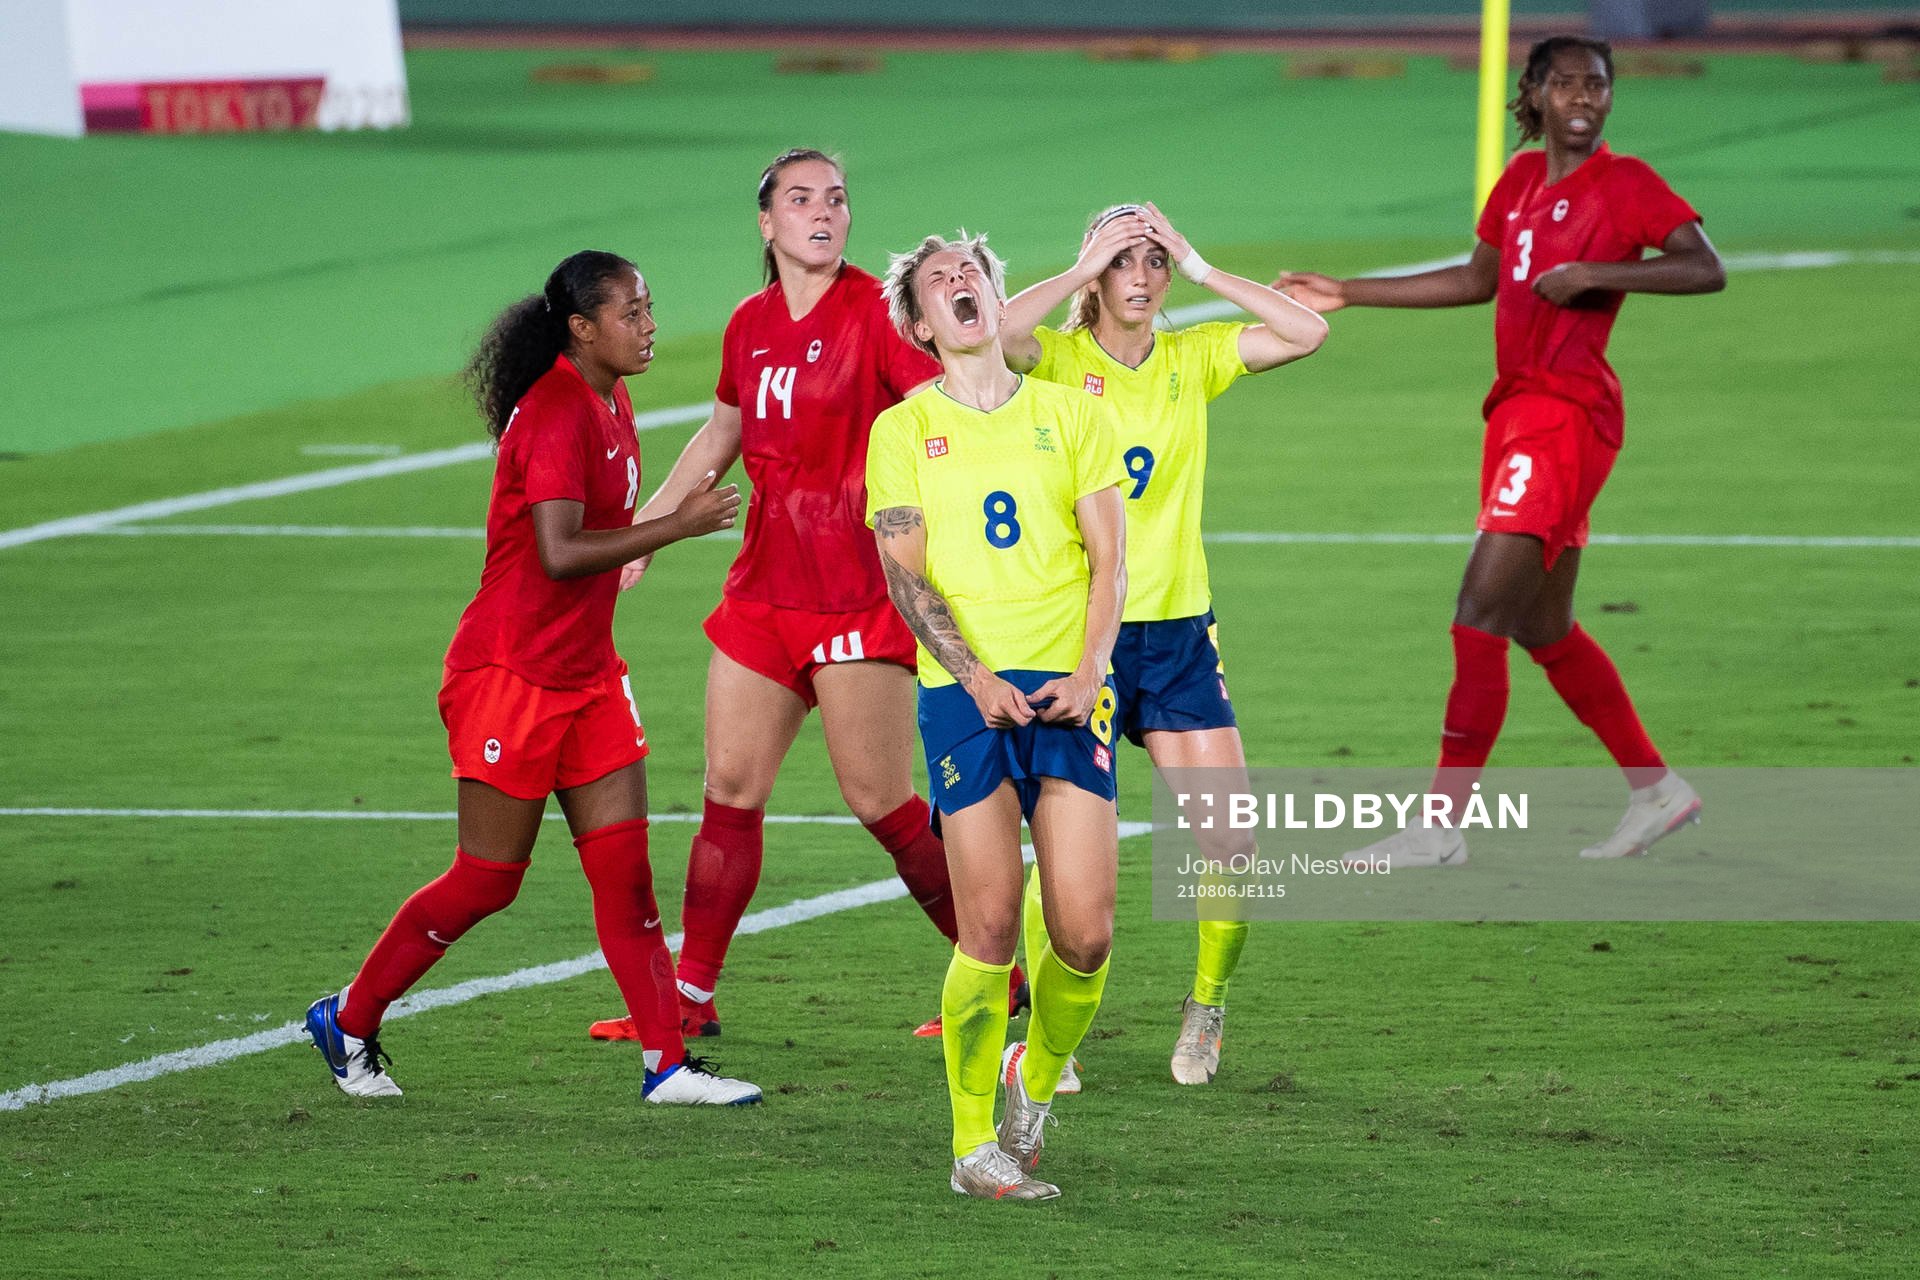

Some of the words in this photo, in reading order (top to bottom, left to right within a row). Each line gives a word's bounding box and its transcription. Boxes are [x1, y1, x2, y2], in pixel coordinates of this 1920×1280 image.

[146, 84, 295, 131] TOKYO
[1512, 229, 1533, 281] 3
[756, 366, 797, 419] 14
[927, 438, 945, 448] UNI
[928, 446, 947, 458] QLO
[623, 455, 638, 510] 8
[1123, 445, 1155, 499] 9
[1498, 453, 1532, 506] 3
[983, 490, 1021, 549] 8
[1090, 685, 1117, 746] 8
[944, 771, 961, 790] SWE
